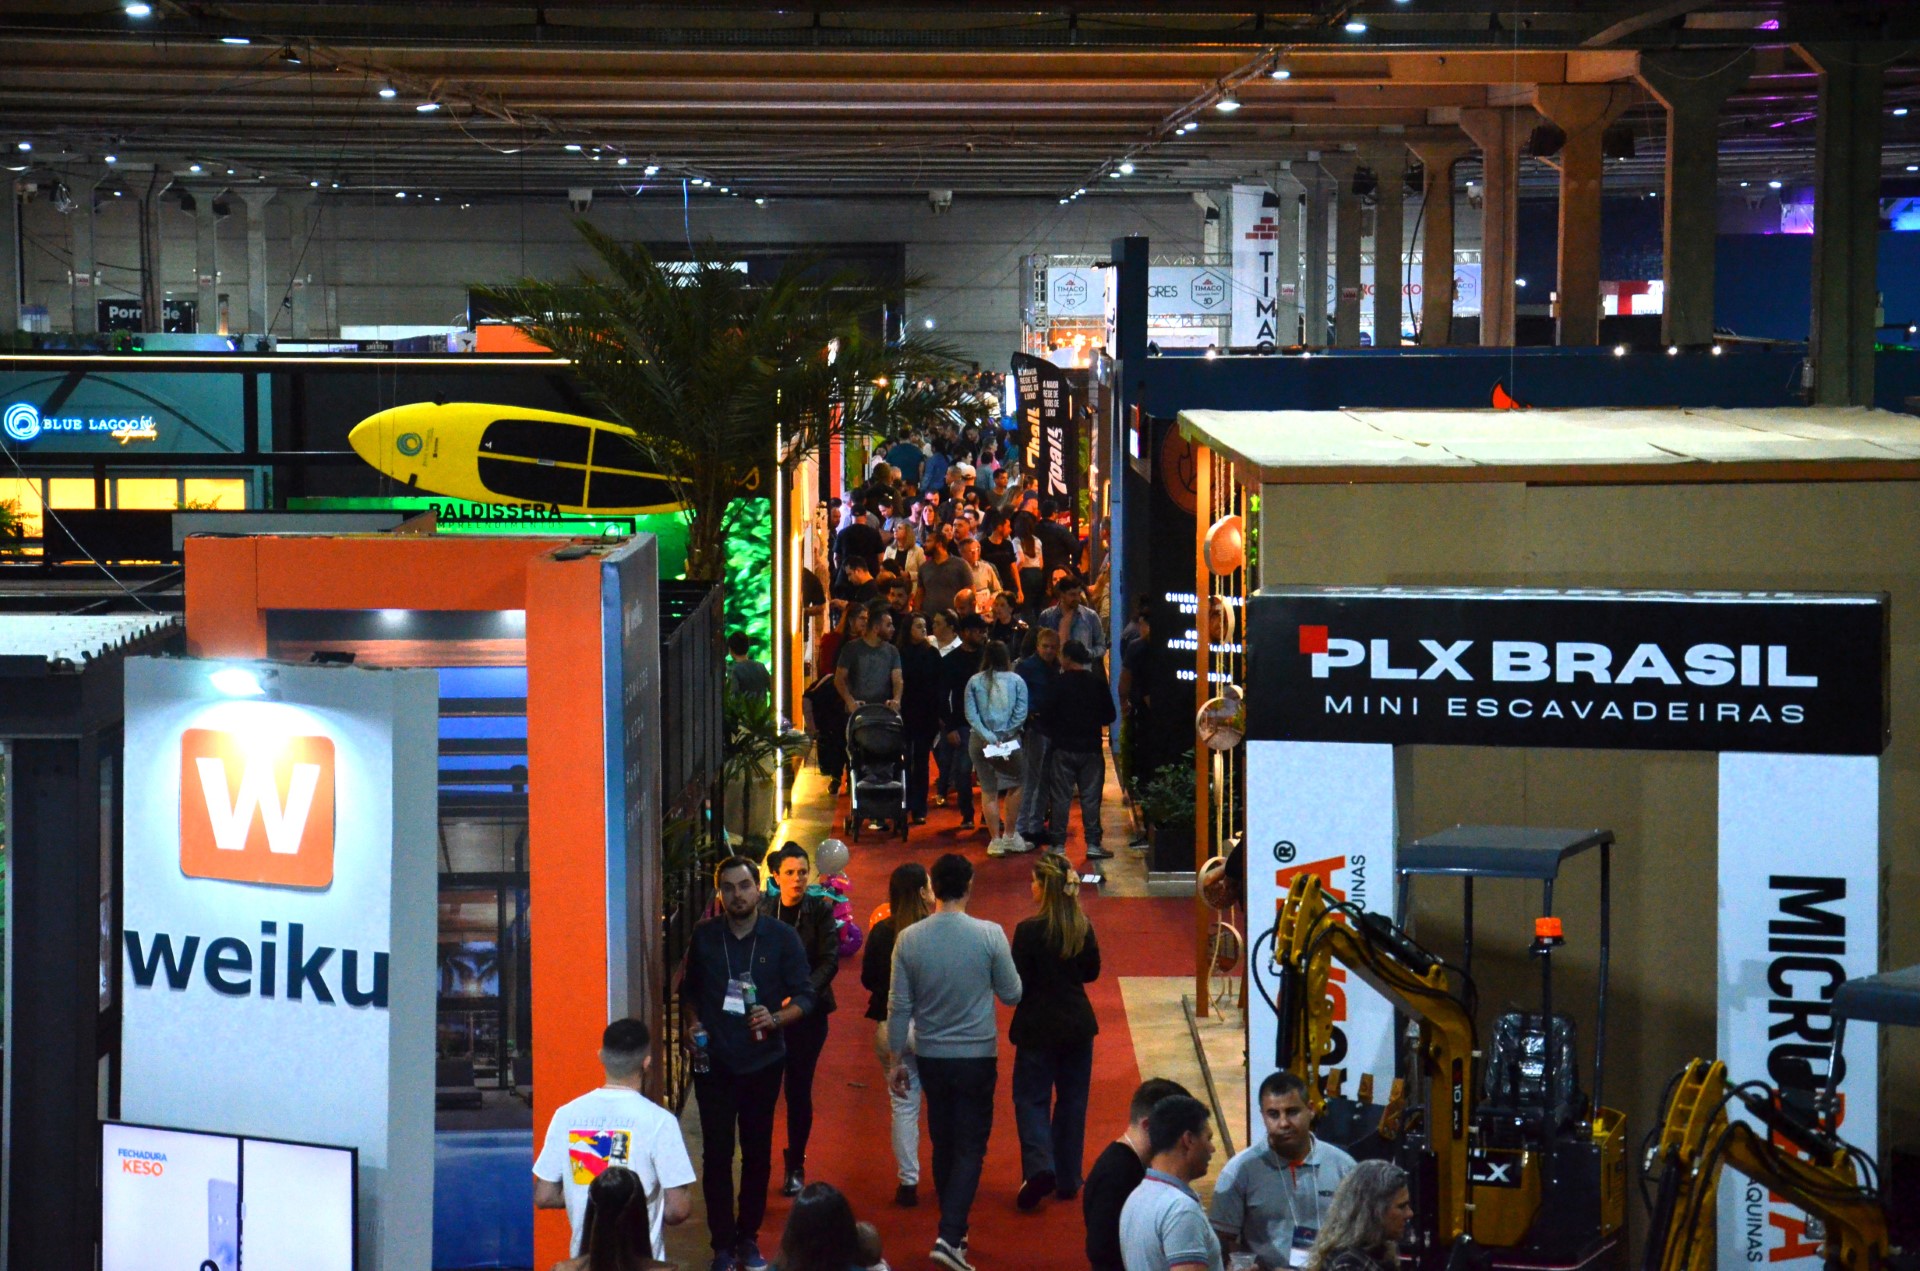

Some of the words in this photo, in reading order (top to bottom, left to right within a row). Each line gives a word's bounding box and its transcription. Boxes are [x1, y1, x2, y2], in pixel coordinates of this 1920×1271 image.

[1056, 285, 1085, 293] TIMACO
[43, 418, 82, 430] BLUE
[429, 502, 562, 519] BALDISSERA
[436, 521, 564, 529] MPREENDIMENTOS
[1311, 638, 1475, 681] PLX
[1492, 640, 1819, 688] BRASIL
[1325, 695, 1419, 716] MINI
[1447, 697, 1805, 724] ESCAVADEIRAS
[123, 920, 390, 1010] weiku
[117, 1147, 168, 1162] FECHADURA
[122, 1159, 164, 1177] KESO
